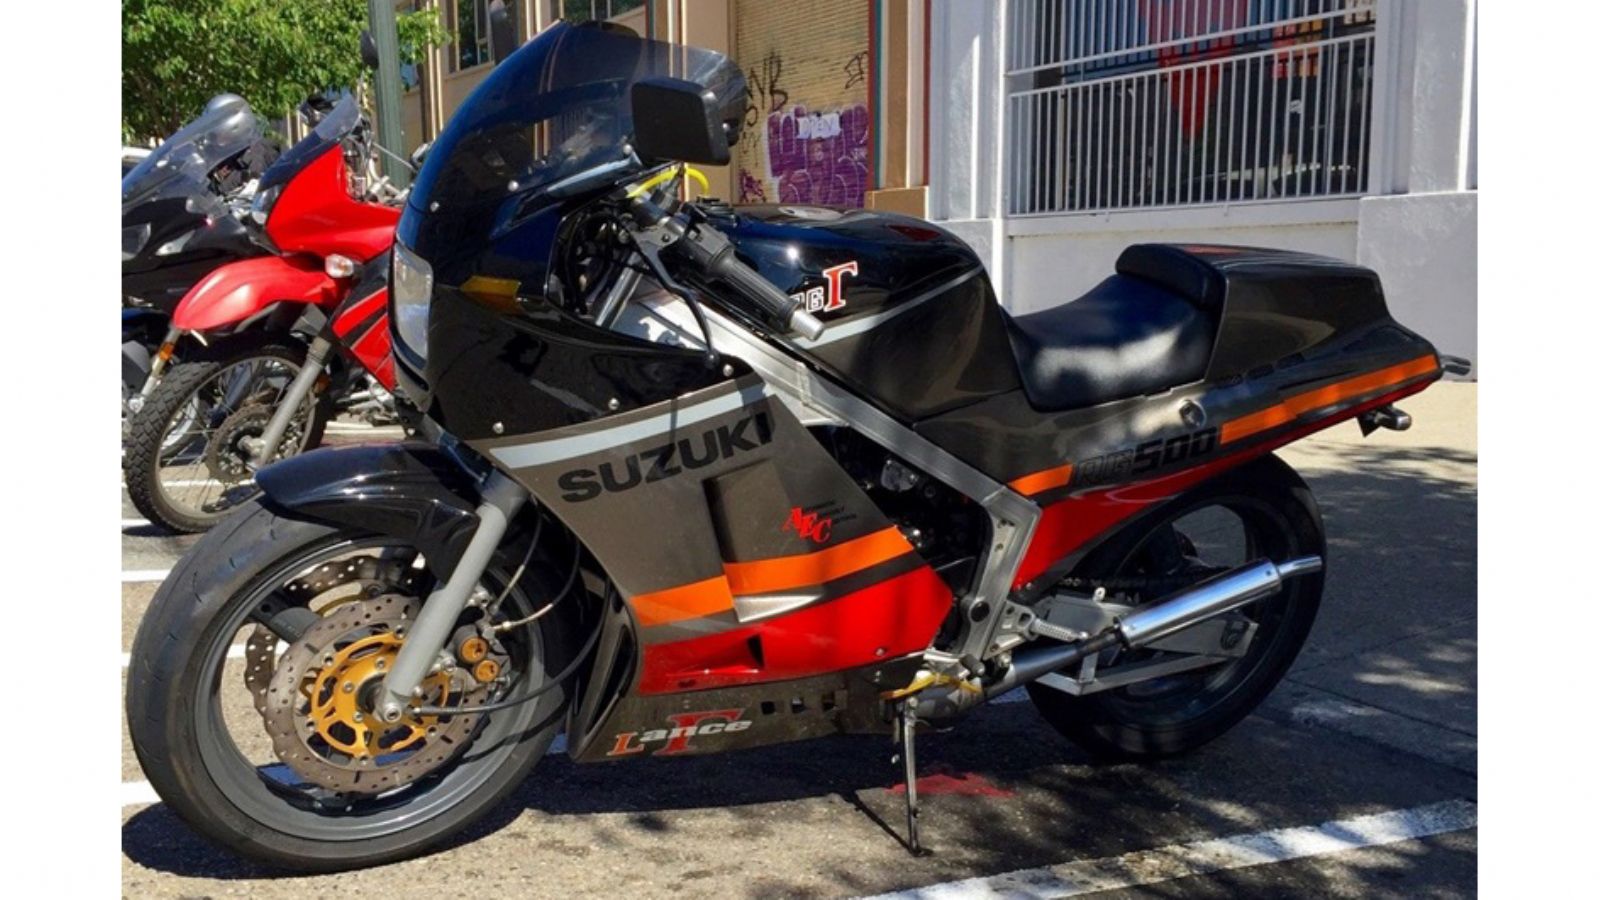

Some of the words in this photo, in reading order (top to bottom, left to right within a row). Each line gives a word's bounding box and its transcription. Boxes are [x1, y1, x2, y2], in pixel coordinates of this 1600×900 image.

[557, 411, 773, 503] SUZUKI
[783, 506, 832, 543] AEC
[606, 720, 753, 756] Lance
